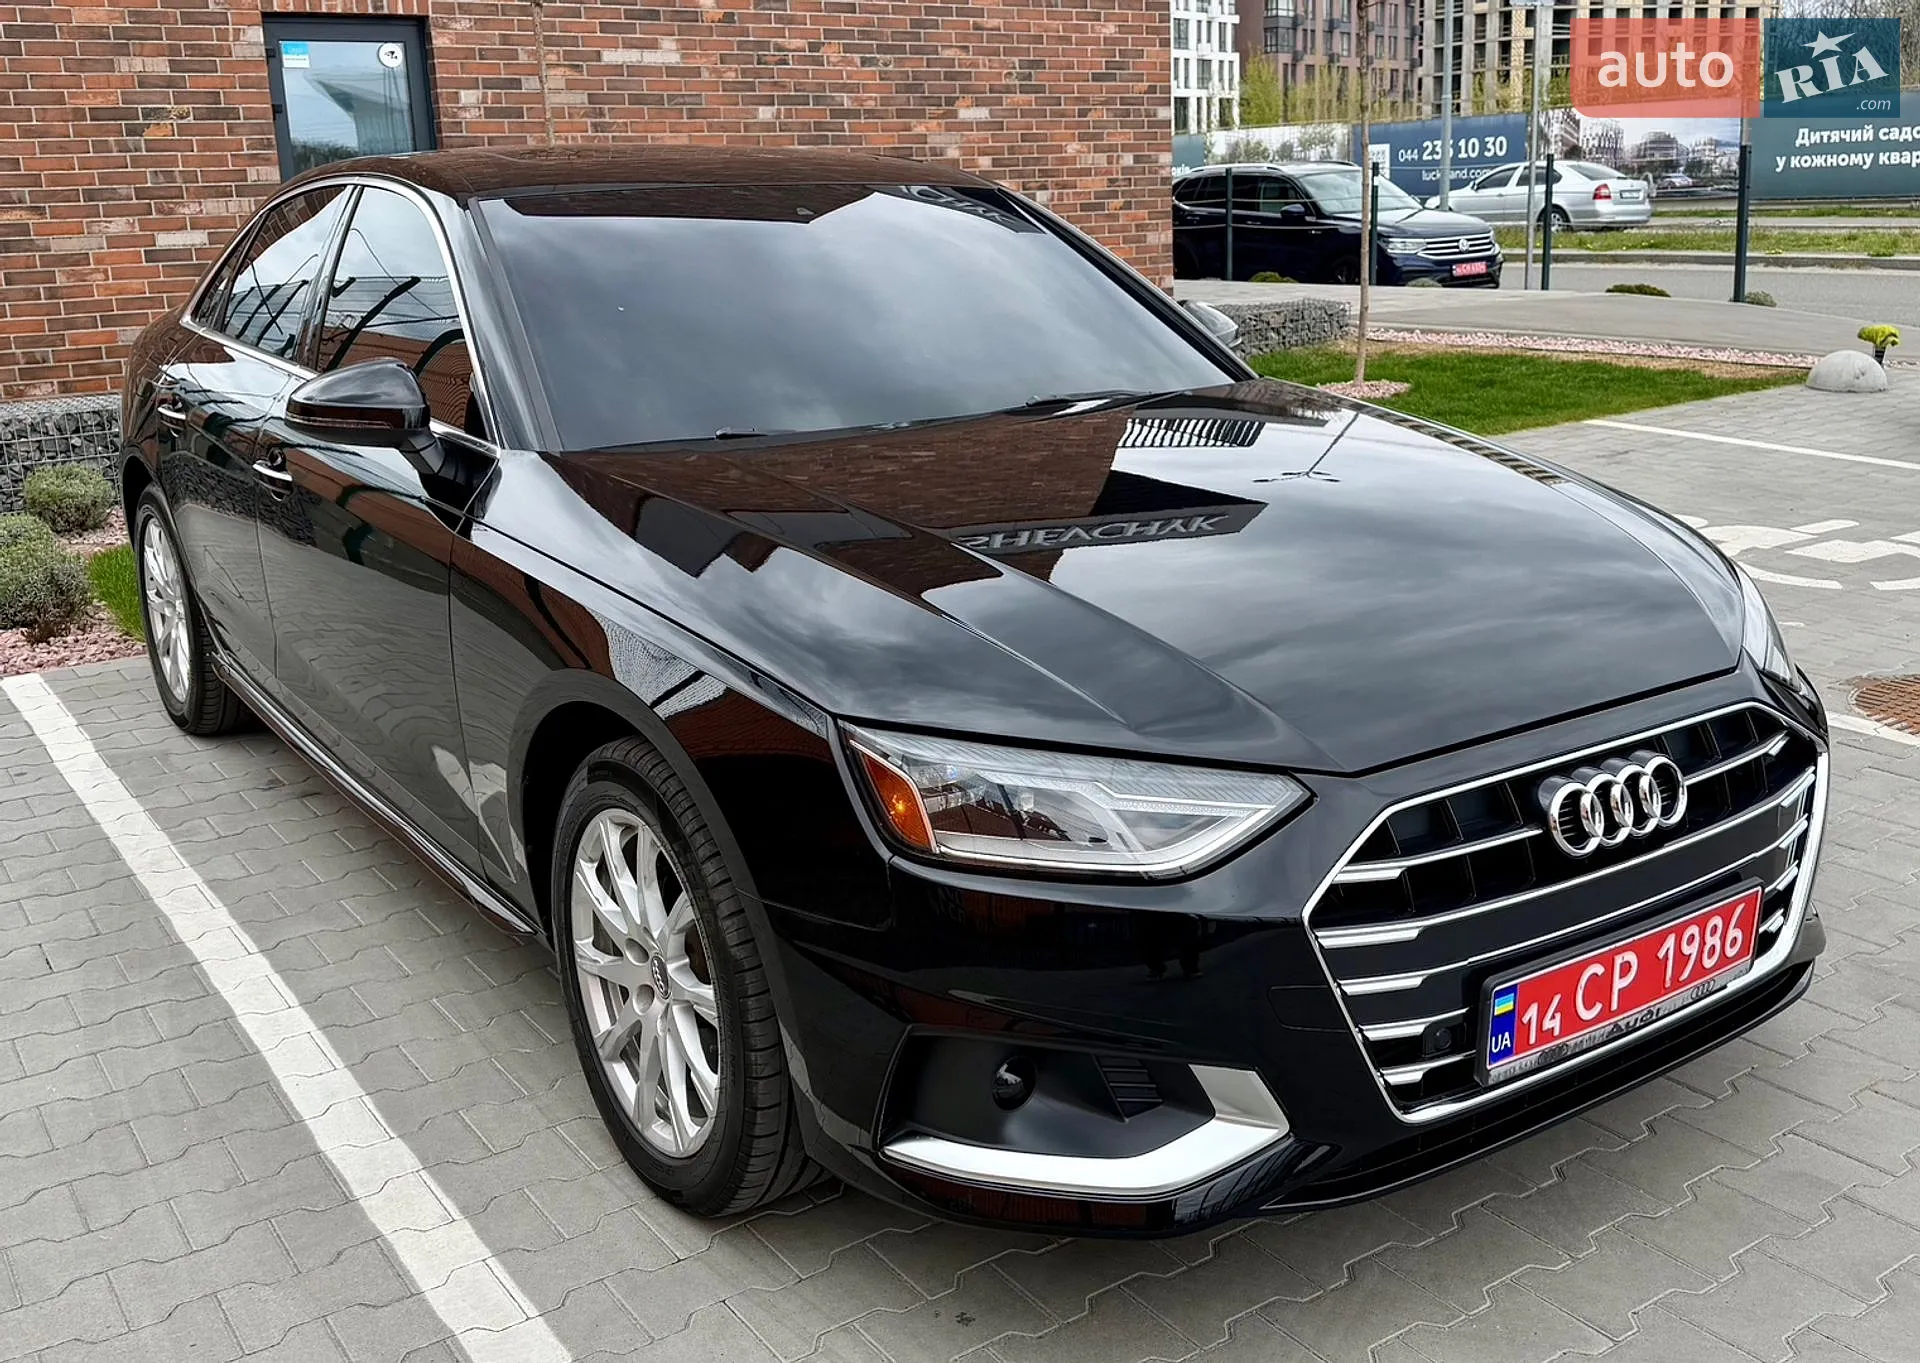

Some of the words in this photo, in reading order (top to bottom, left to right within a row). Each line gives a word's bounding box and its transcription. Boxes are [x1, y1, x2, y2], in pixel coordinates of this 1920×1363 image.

[1795, 124, 1874, 147] Дитячий
[1398, 148, 1418, 162] 044
[1458, 137, 1480, 158] 10
[1484, 136, 1507, 157] 30
[1775, 155, 1787, 172] у
[1790, 152, 1874, 169] кожному
[1878, 150, 1920, 168] квар
[1521, 993, 1562, 1045] 14
[1575, 950, 1639, 1022] CP
[1657, 902, 1746, 989] 1986
[1491, 1030, 1512, 1053] UA
